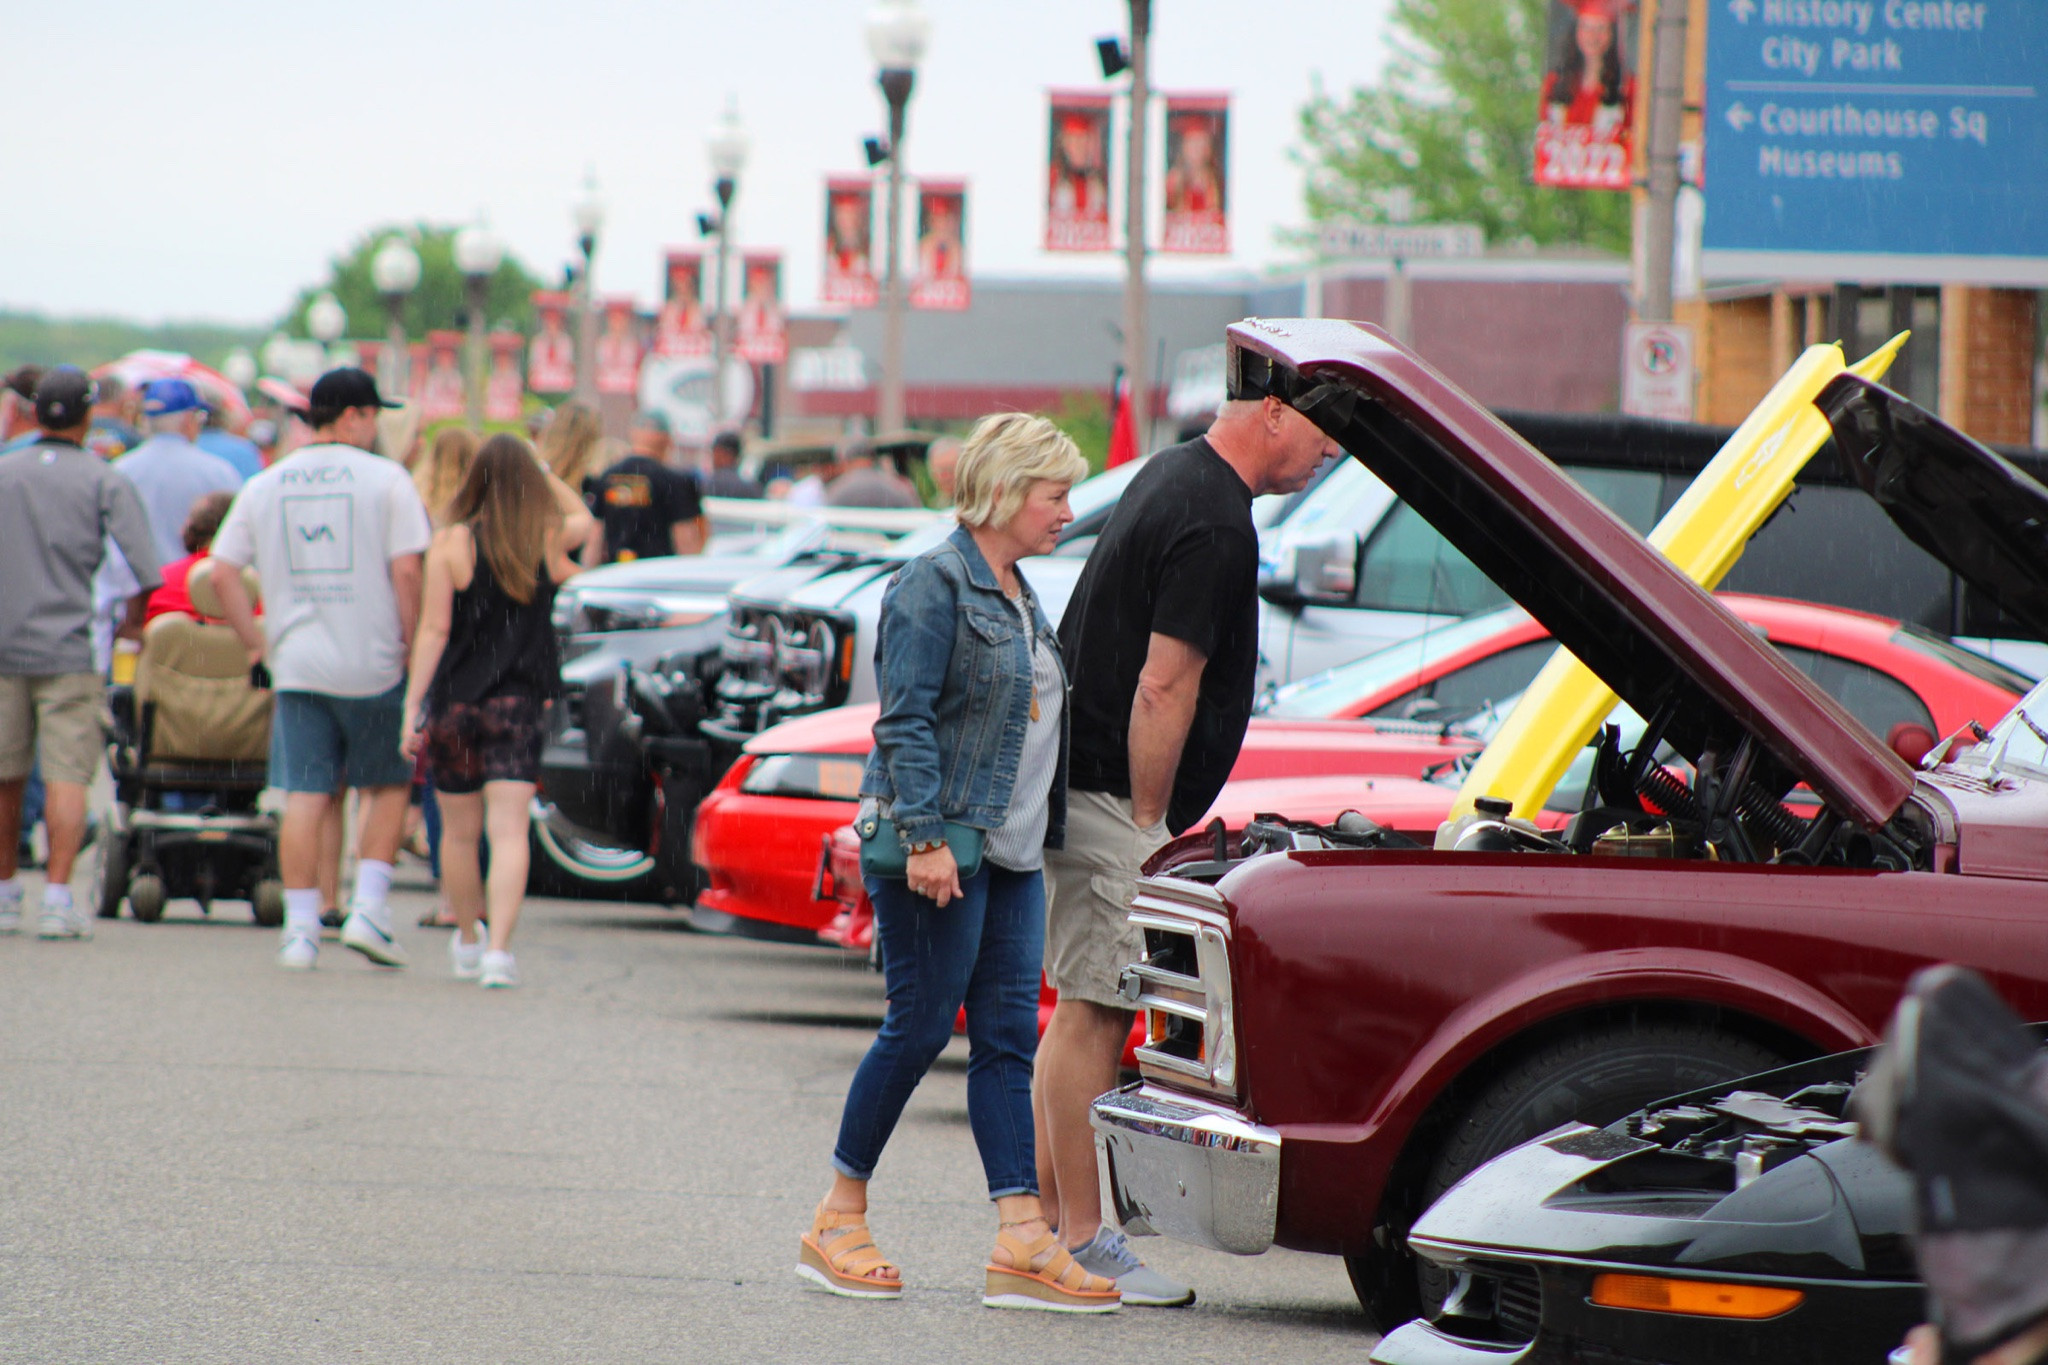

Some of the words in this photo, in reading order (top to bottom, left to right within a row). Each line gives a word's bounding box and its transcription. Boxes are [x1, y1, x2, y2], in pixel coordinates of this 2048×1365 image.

[1762, 0, 1873, 34] History
[1885, 0, 1986, 29] Center
[1761, 36, 1820, 76] City
[1832, 37, 1902, 69] Park
[1760, 101, 1939, 138] Courthouse
[1949, 106, 1987, 145] Sq
[1543, 140, 1626, 186] 2022
[1759, 145, 1903, 179] Museums
[281, 466, 354, 484] RVCA
